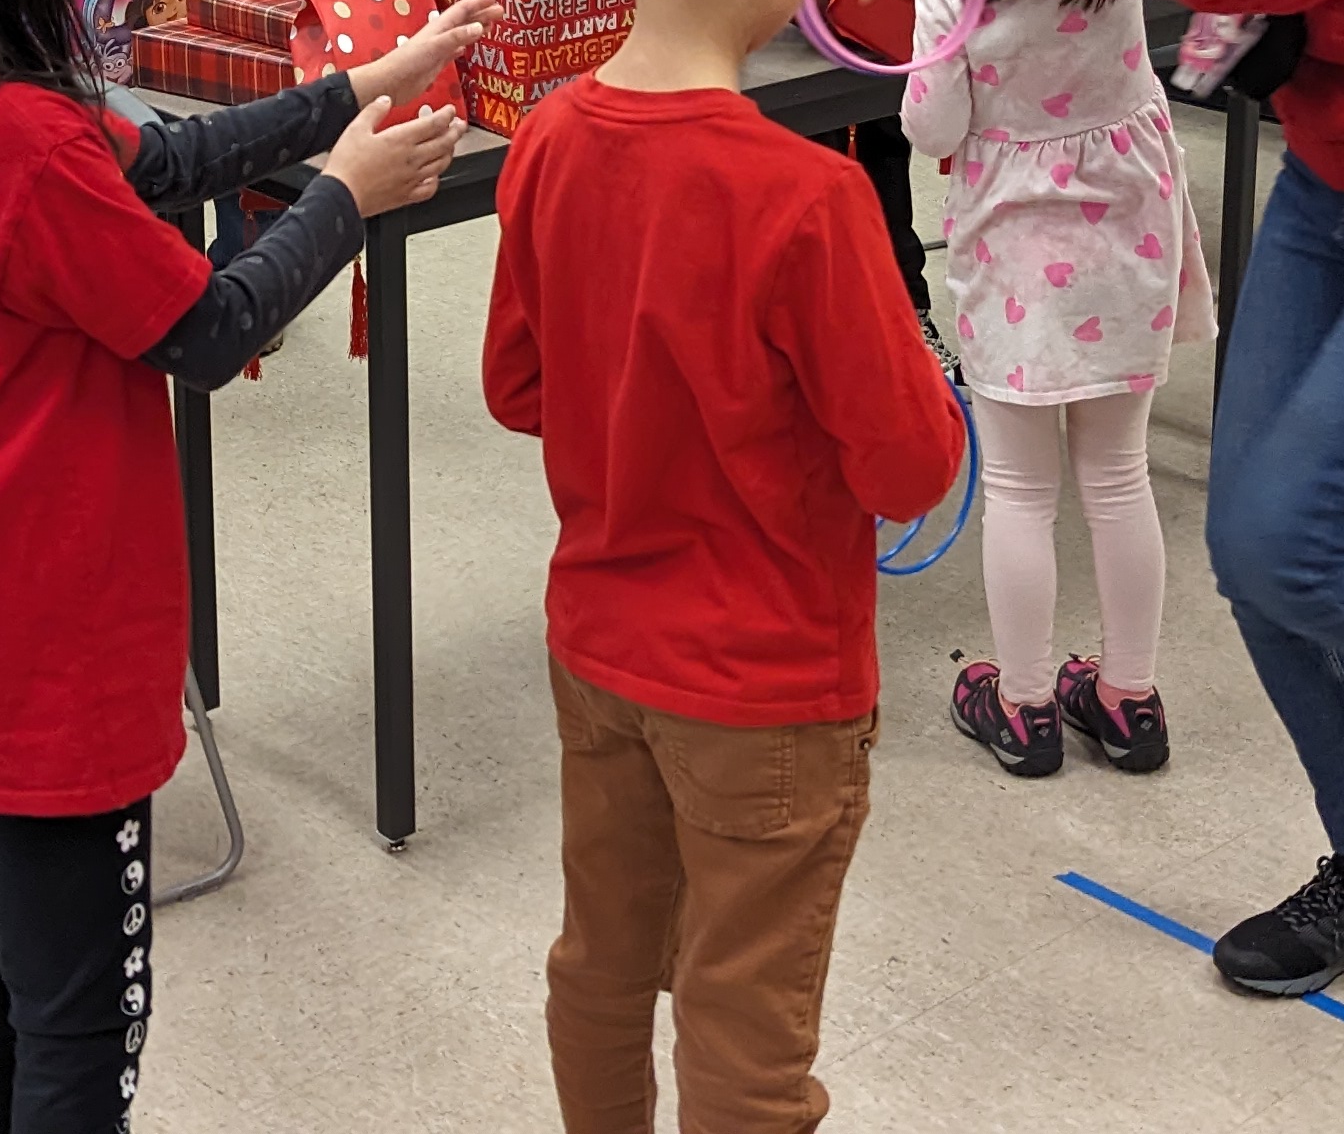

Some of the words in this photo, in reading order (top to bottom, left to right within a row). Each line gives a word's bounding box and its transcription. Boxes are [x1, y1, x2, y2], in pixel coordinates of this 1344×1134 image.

[494, 24, 556, 47] HAPPY
[559, 12, 617, 41] PARTY
[470, 42, 509, 76] YAY
[481, 94, 521, 131] YAY
